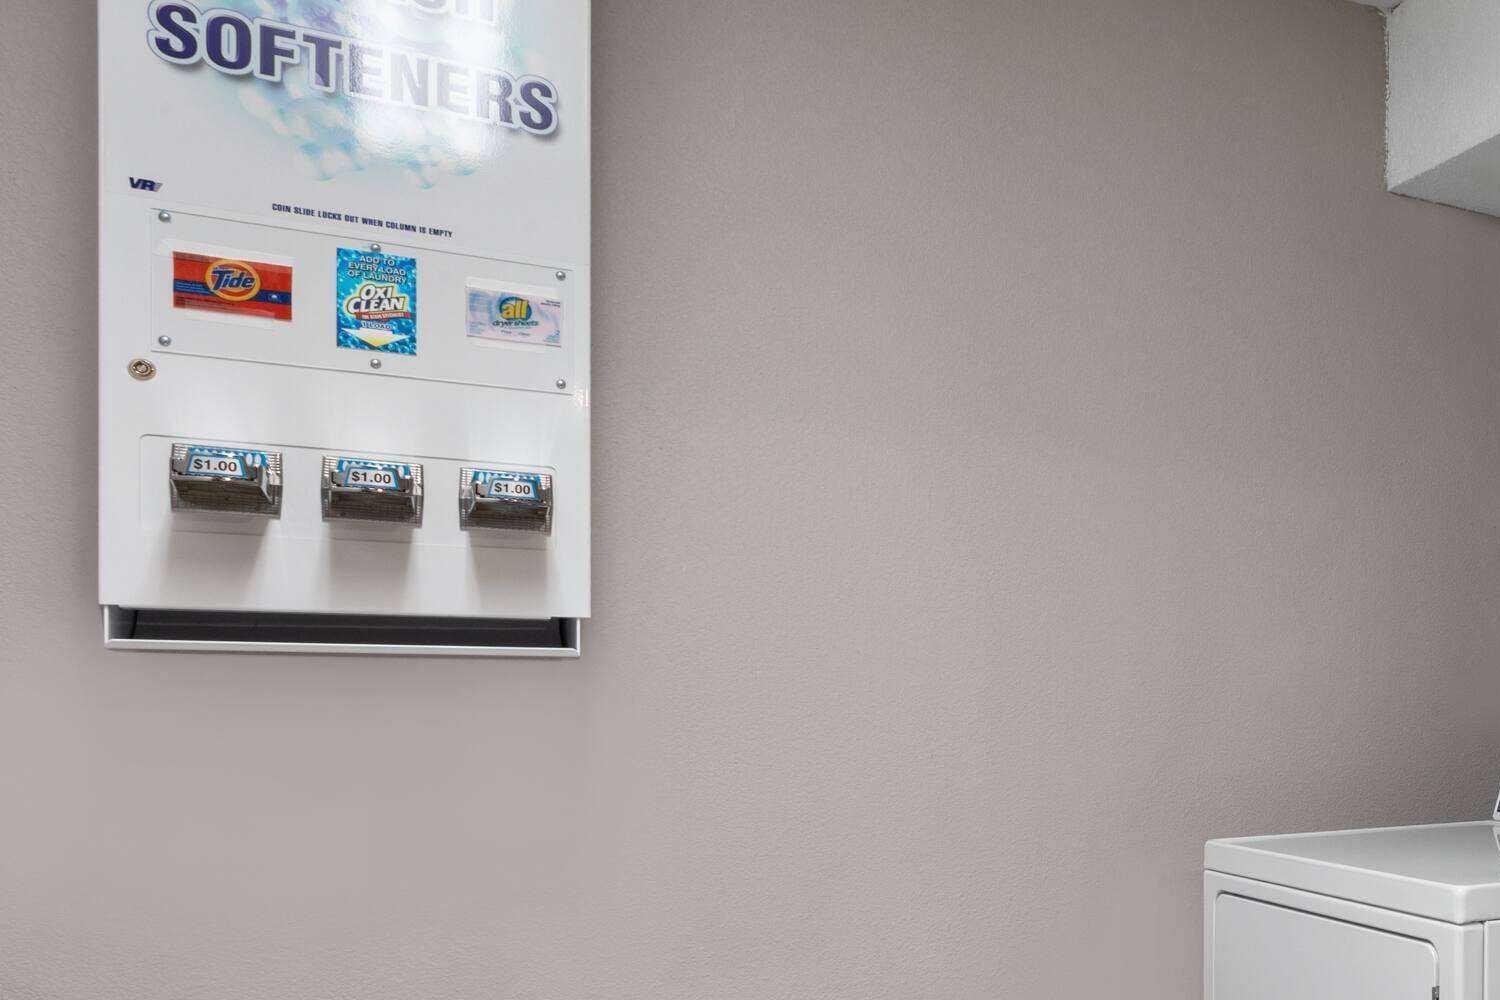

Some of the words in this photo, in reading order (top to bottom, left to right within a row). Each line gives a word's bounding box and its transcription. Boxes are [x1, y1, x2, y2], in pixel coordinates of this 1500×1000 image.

[154, 3, 556, 132] SOFTENERS
[271, 203, 291, 213] COIN
[293, 206, 315, 217] SLIDE
[317, 210, 342, 221] LOCKS
[344, 214, 359, 223] OUT
[361, 217, 384, 227] WHEN
[385, 220, 417, 232] COLUMN
[419, 225, 427, 234] IS
[428, 227, 453, 238] EMPTY
[348, 261, 378, 272] EVERY
[380, 266, 407, 276] LOAD
[359, 255, 380, 264] ADD
[383, 258, 395, 266] TO
[211, 267, 256, 291] Tide
[347, 269, 362, 277] OF
[363, 271, 407, 284] LAUNDRY
[360, 284, 394, 301] OXI
[347, 296, 405, 314] CLEAN
[501, 299, 530, 320] all
[193, 458, 238, 472] $1.00
[351, 470, 392, 485] $1.00
[494, 481, 531, 496] $1.00
